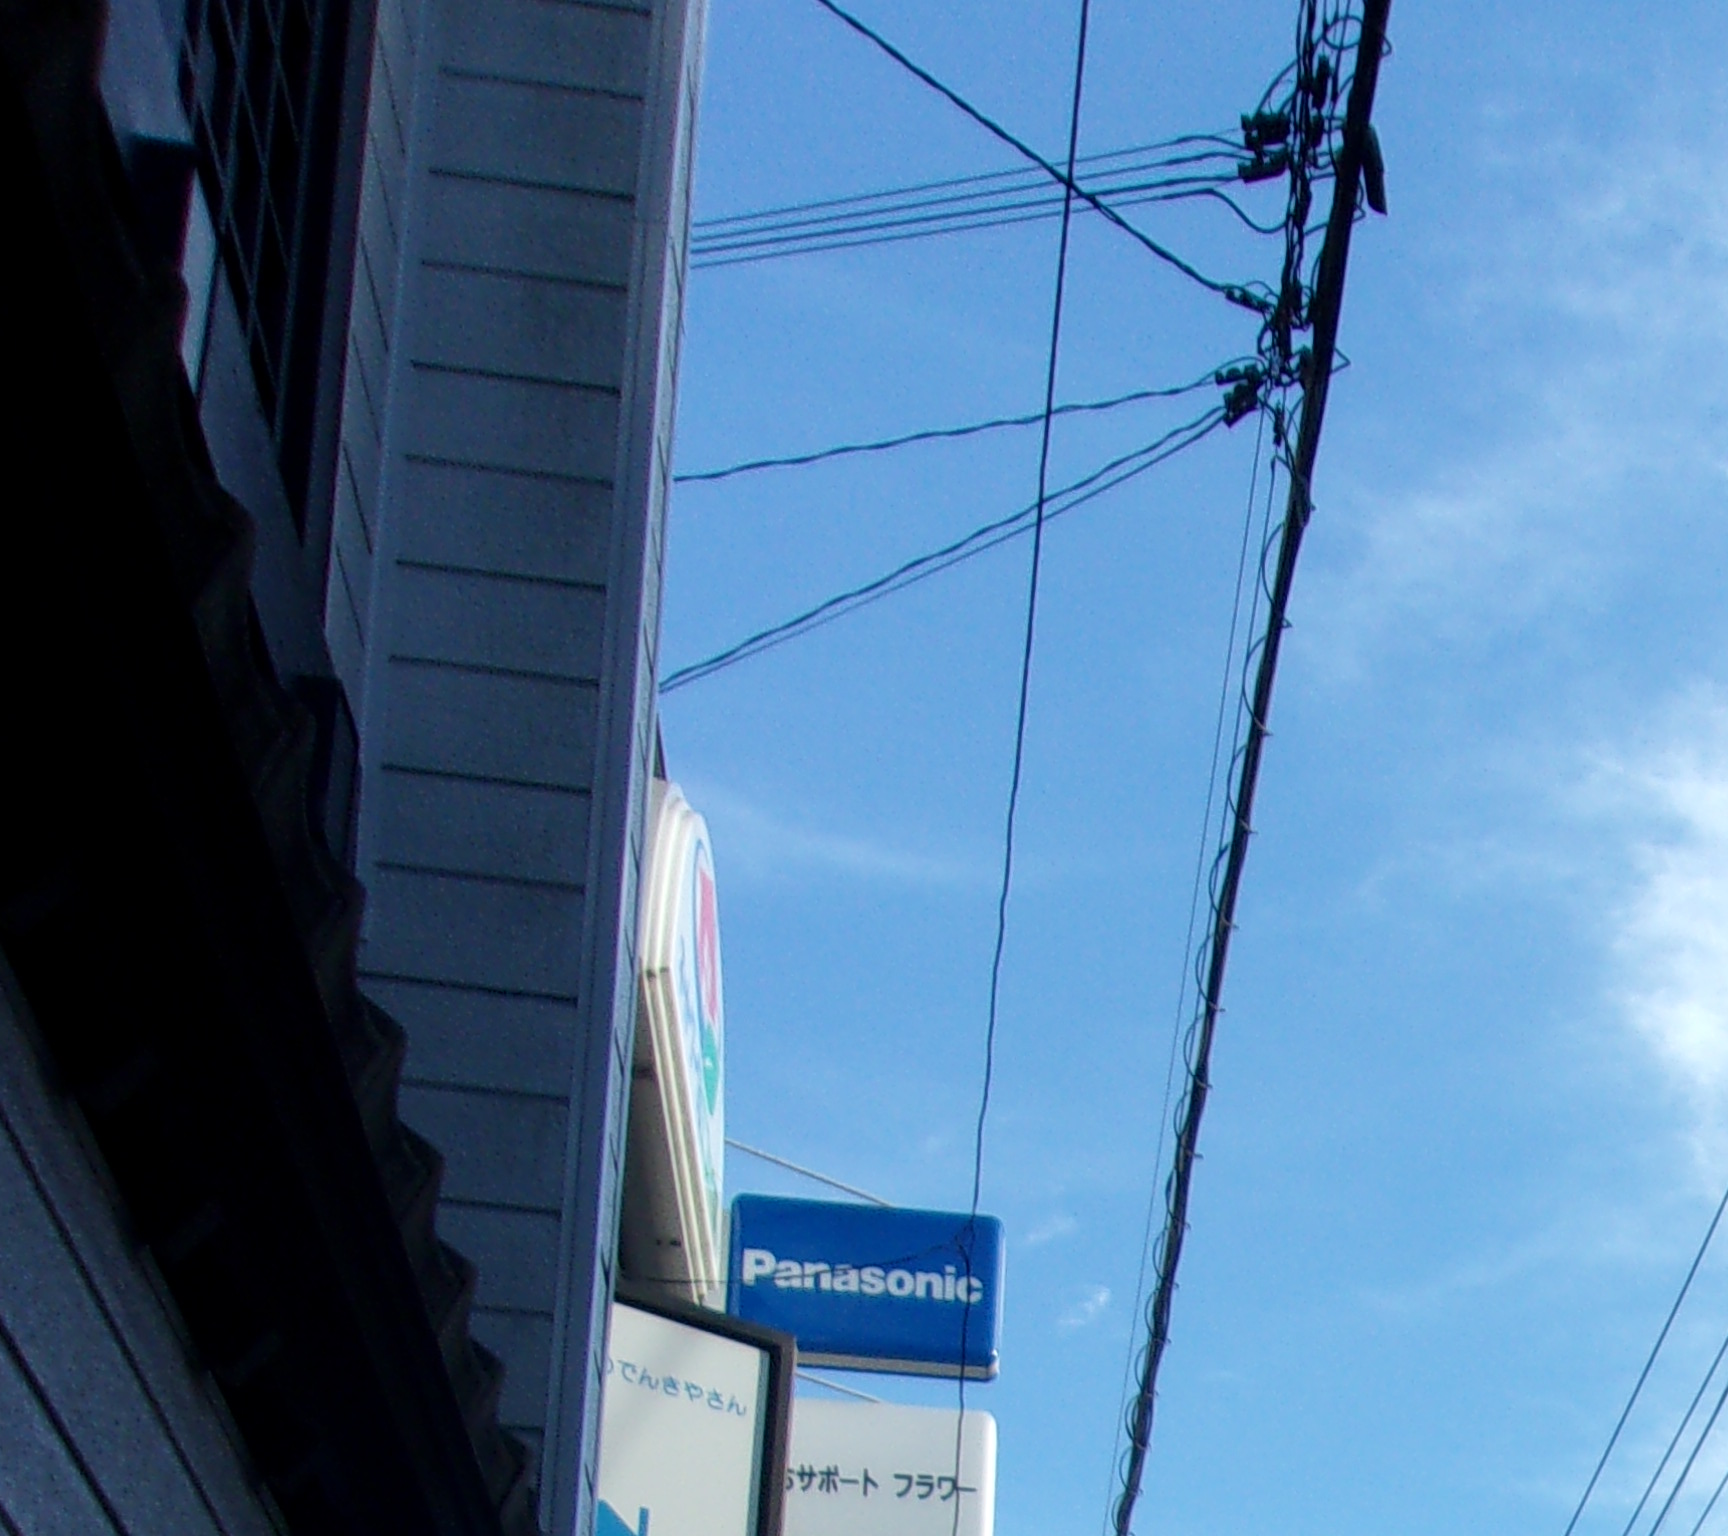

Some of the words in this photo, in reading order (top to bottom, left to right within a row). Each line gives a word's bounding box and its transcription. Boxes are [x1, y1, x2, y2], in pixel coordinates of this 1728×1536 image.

[742, 1247, 984, 1304] Panasonic
[606, 1356, 748, 1419] でんきやさん
[893, 1472, 978, 1502] フラワー
